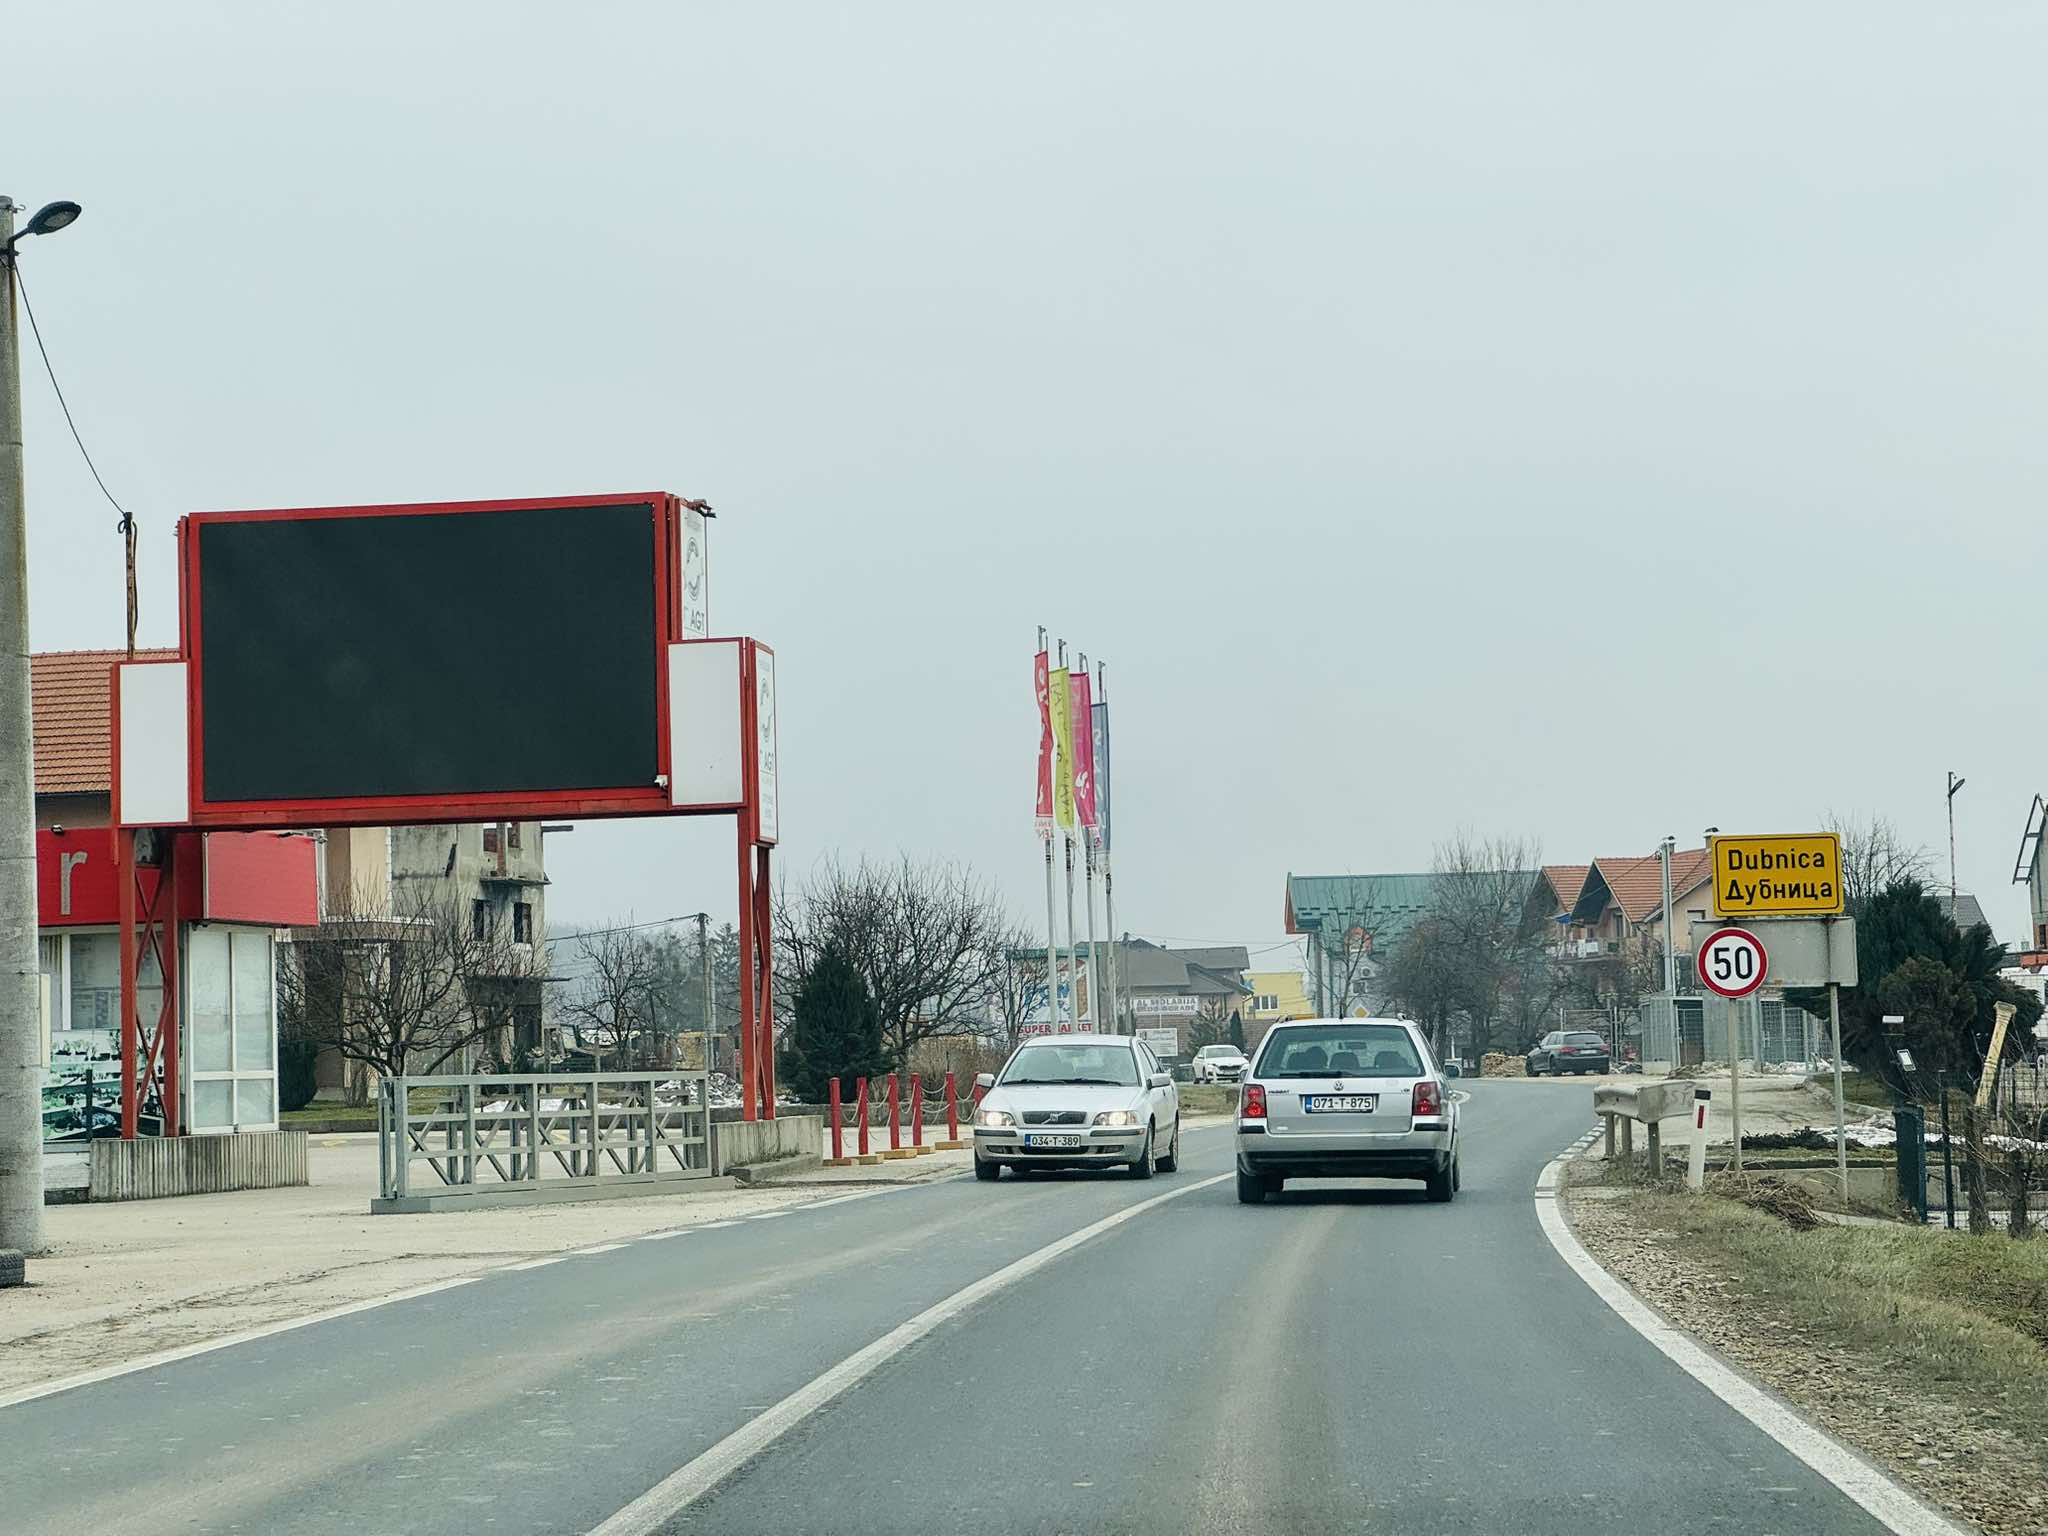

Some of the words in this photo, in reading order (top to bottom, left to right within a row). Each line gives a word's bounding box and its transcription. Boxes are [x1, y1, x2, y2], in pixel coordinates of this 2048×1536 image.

[1728, 848, 1825, 870] Dubnica
[1725, 879, 1832, 905] Дубница
[1714, 946, 1753, 980] 50
[1313, 1098, 1371, 1109] 071-T-875
[1031, 1136, 1079, 1146] 034-T-389
